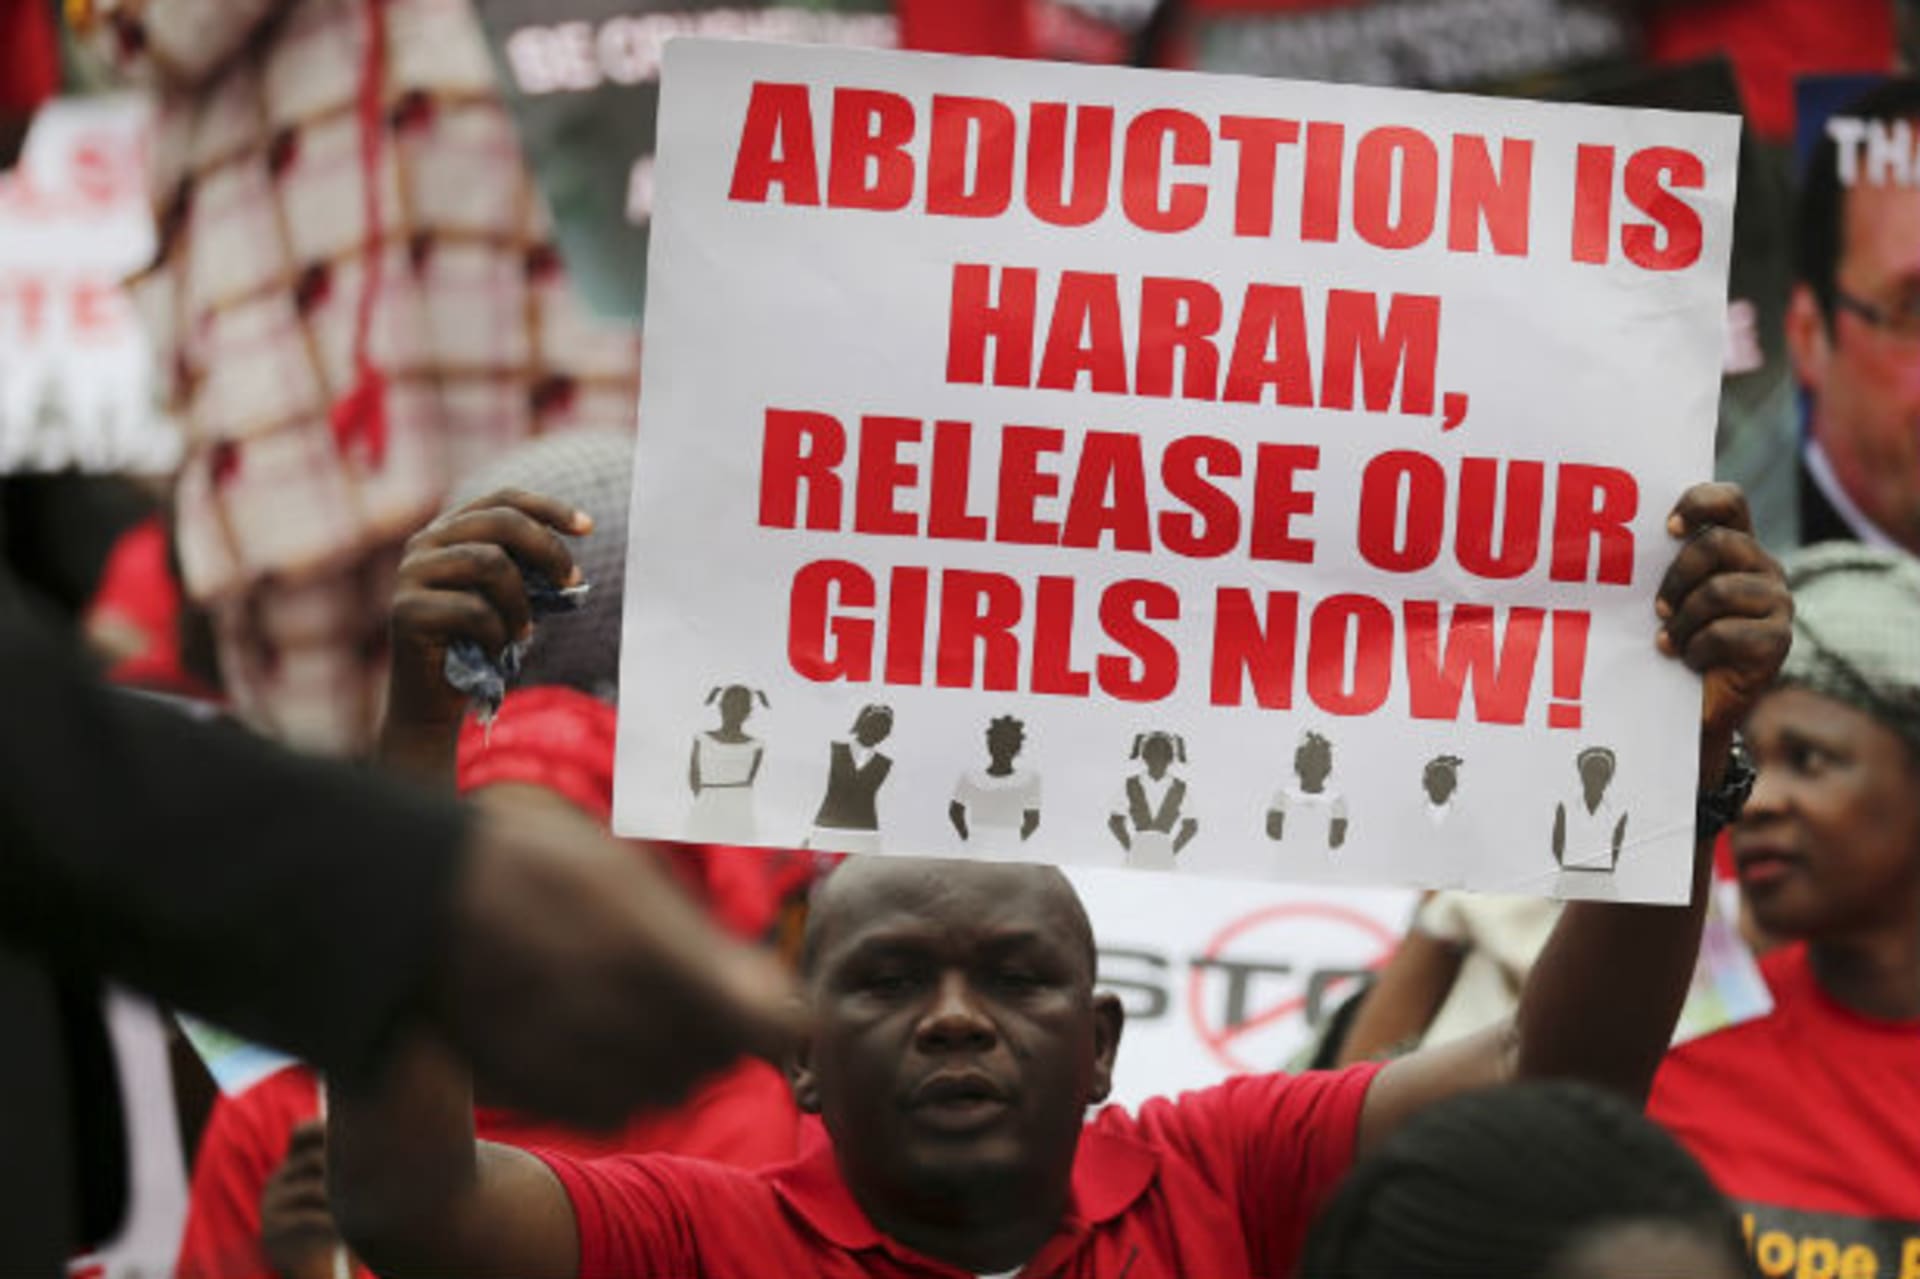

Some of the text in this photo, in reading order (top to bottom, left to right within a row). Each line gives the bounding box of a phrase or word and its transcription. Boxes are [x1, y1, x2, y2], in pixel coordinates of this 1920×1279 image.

[728, 82, 1532, 257] ABDUCTION
[1572, 144, 1705, 271] IS
[946, 263, 1468, 431] HARAM,
[758, 408, 1639, 586] RELEASE OUR
[788, 559, 1591, 730] GIRLS NOW!
[1743, 1212, 1879, 1279] ope
